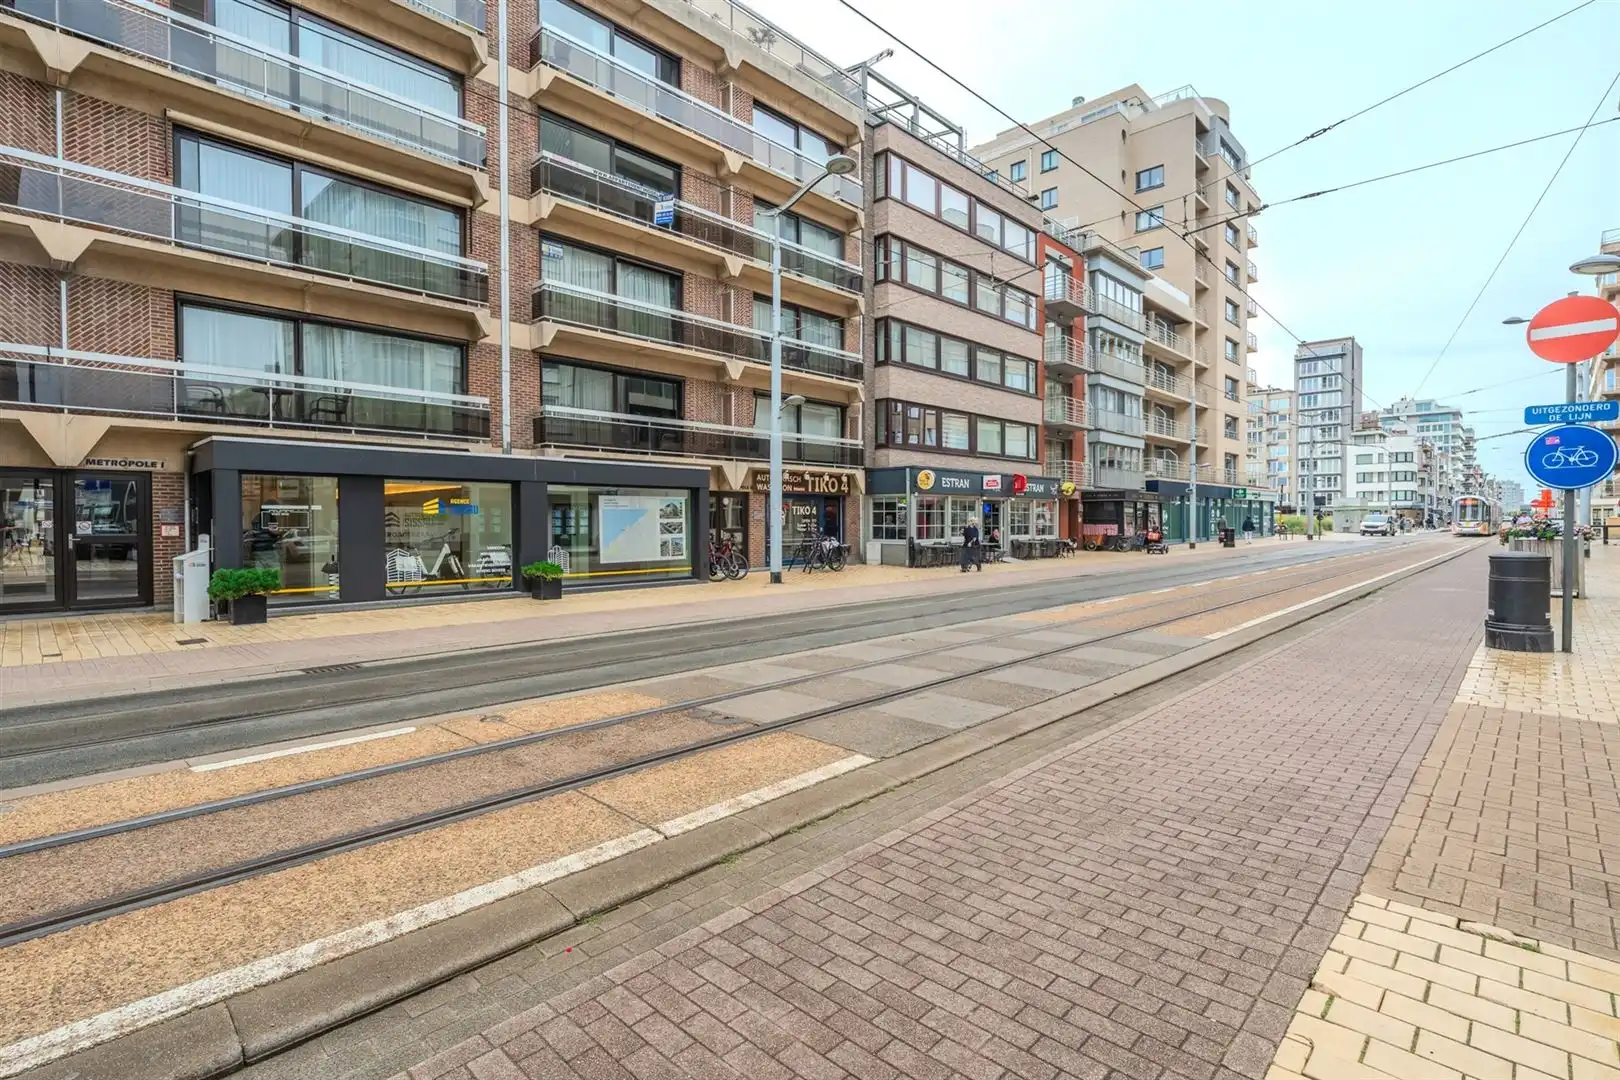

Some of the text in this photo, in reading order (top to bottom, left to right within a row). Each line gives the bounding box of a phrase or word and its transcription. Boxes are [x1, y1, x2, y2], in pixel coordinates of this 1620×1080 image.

[1532, 403, 1611, 415] UITGEZONDERD
[1549, 412, 1592, 422] DE LIJN
[808, 476, 849, 493] TIKO 4
[941, 477, 970, 489] ESTRAN
[1025, 483, 1045, 493] STRAN
[792, 506, 817, 515] TIKO 4
